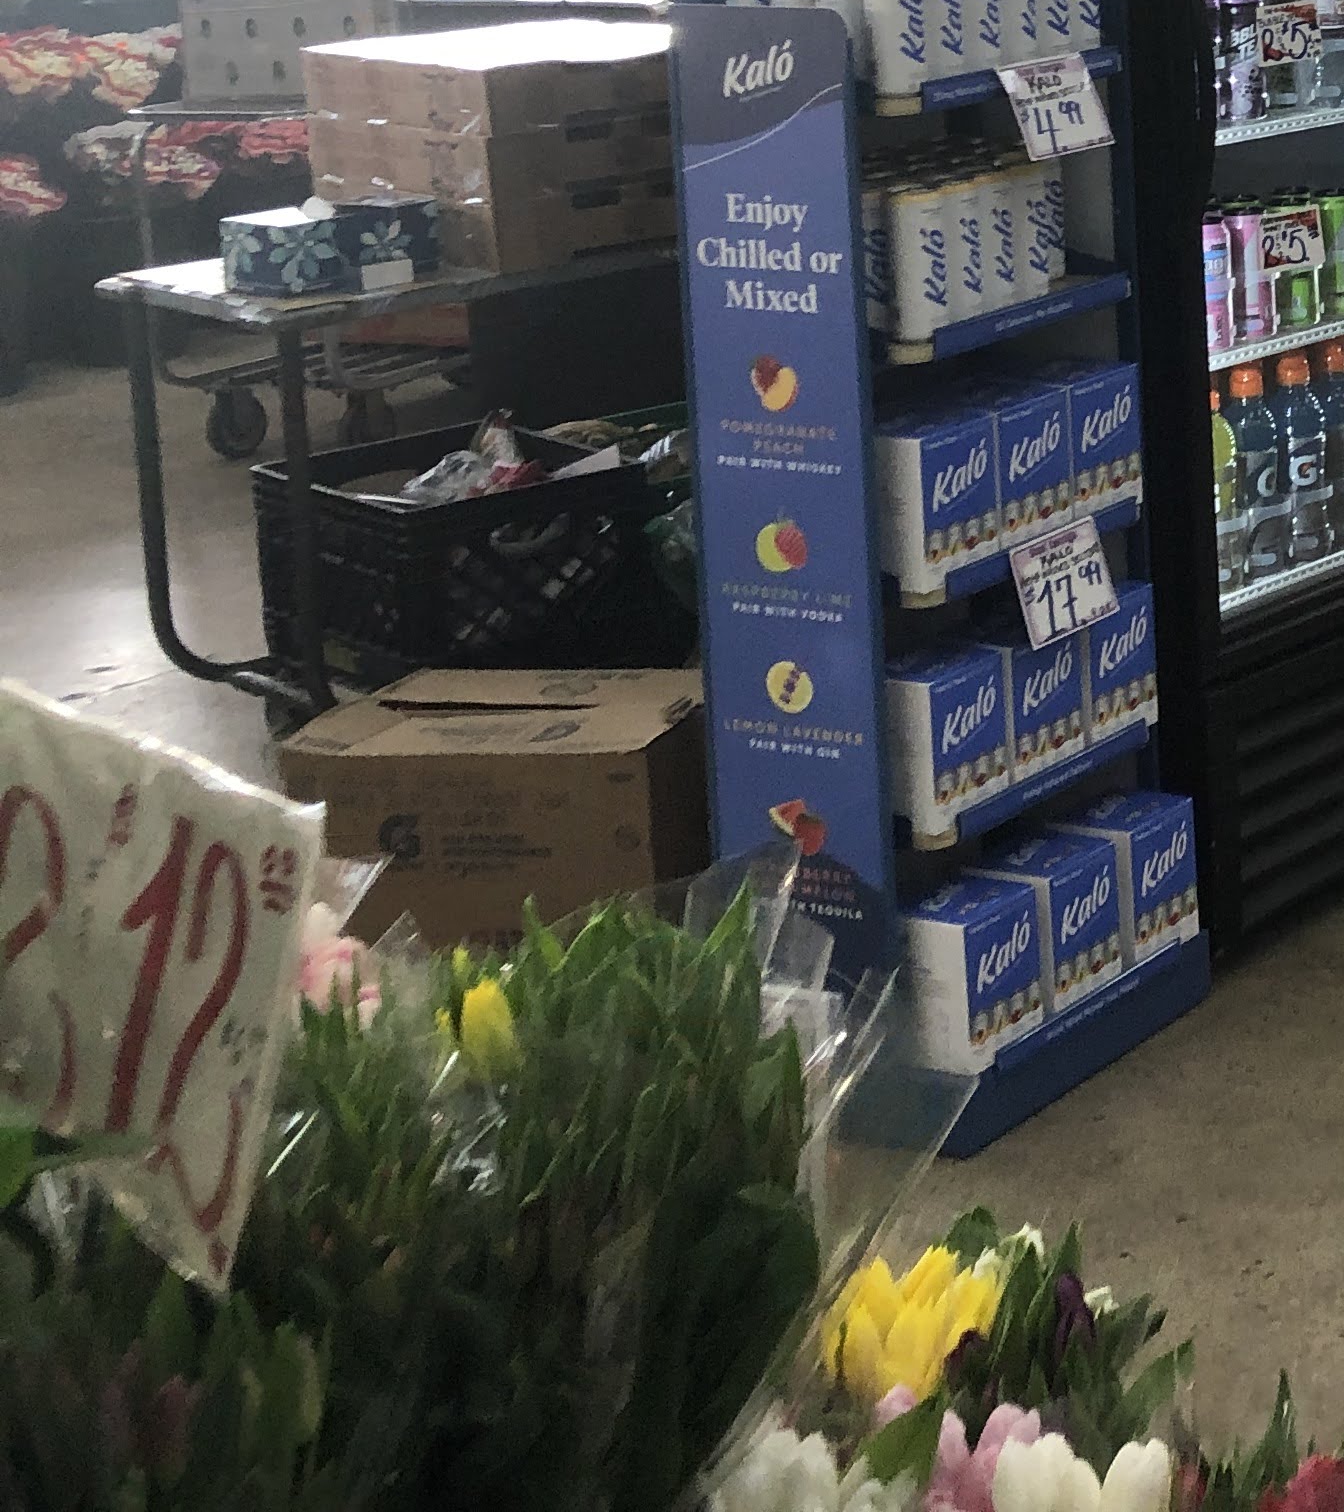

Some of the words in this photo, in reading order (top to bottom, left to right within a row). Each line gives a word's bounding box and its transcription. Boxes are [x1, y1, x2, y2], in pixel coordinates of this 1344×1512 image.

[723, 38, 794, 98] Kaló
[726, 193, 808, 234] Enjoy
[992, 207, 1016, 283] Kaló
[1027, 199, 1050, 274] Kaló
[697, 237, 801, 274] Chilled
[809, 251, 843, 275] or
[919, 228, 948, 307] Kaló
[960, 217, 983, 295] Kaló
[725, 281, 818, 315] Mixed
[1009, 410, 1060, 484] Kaló
[1081, 384, 1131, 454] Kaló
[931, 437, 988, 513] Kaló
[1289, 453, 1318, 487] G
[1023, 640, 1073, 717] Kaló
[1099, 606, 1147, 679] Kaló
[942, 674, 997, 755] Kaló
[1141, 820, 1187, 898] Kaló
[1060, 864, 1111, 945] Kaló
[977, 909, 1031, 995] Kaló
